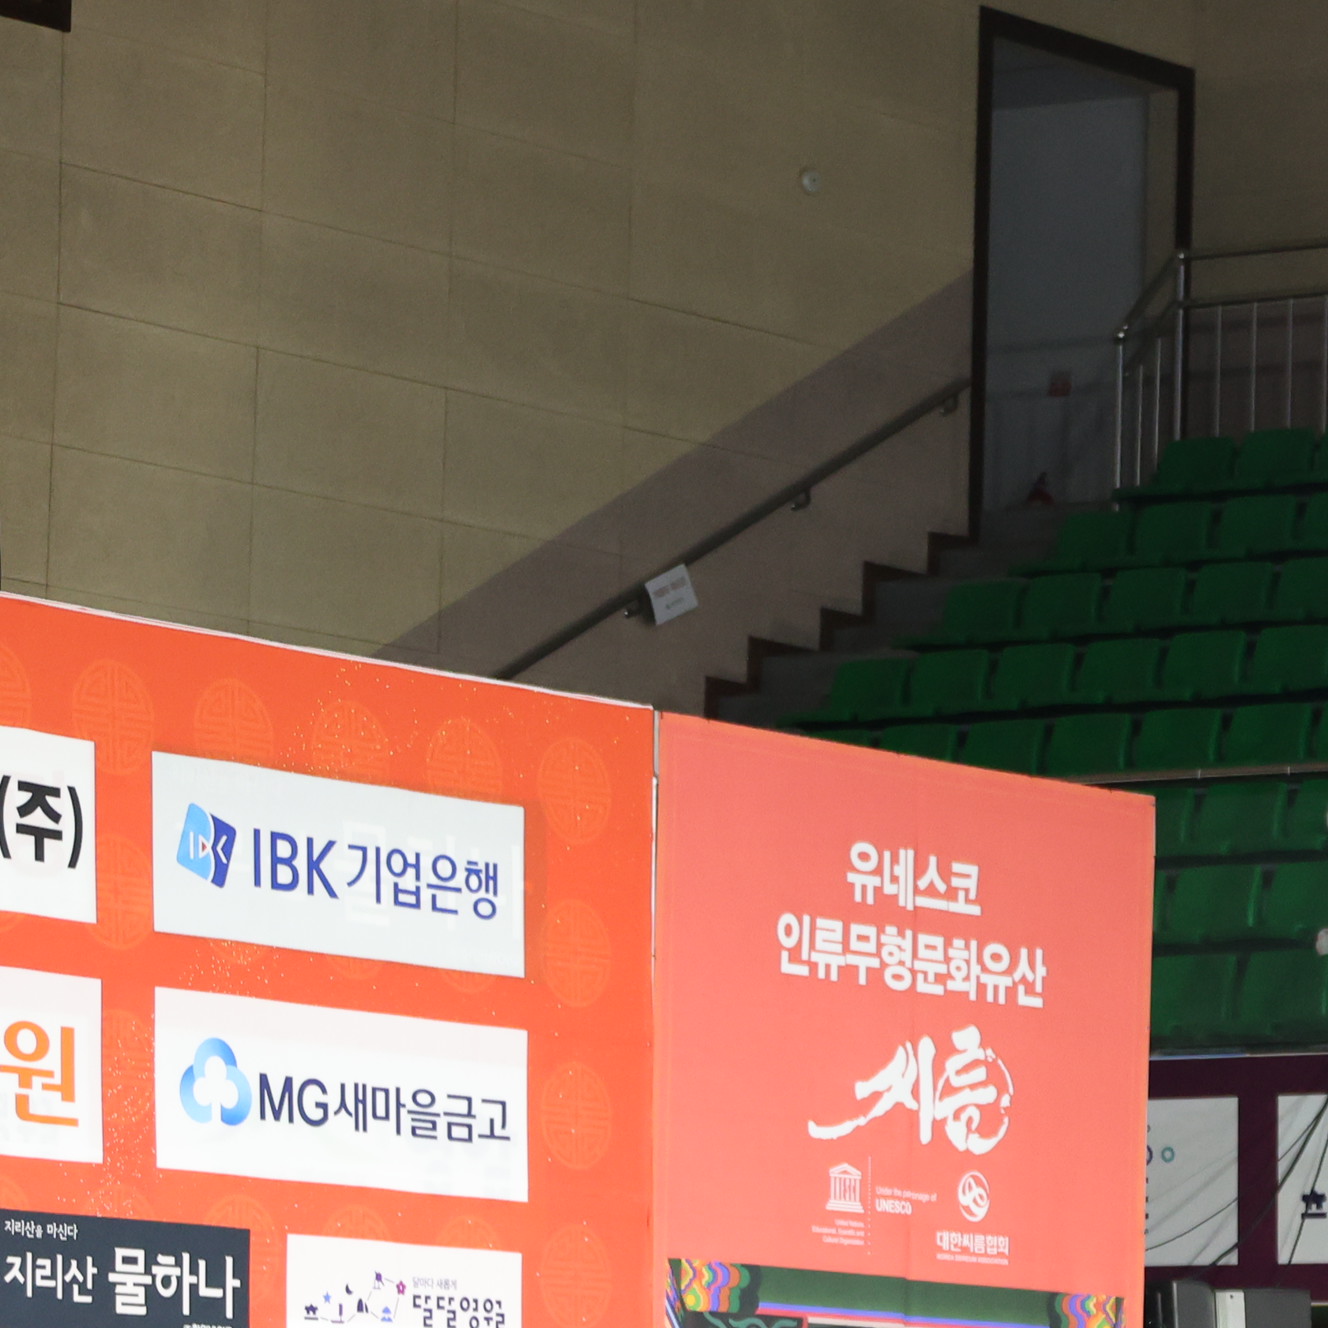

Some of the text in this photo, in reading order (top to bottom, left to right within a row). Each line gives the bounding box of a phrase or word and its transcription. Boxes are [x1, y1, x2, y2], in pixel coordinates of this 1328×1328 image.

[846, 841, 982, 916] 유네스코
[776, 911, 1047, 1008] 인류무형문화유산
[259, 1072, 511, 1143] MG새마을금고
[807, 1025, 1014, 1156] 씨름
[4, 1218, 78, 1241] 지리산을 마신다
[875, 1198, 912, 1215] UNESCO
[936, 1230, 1009, 1256] 대한씨름협회
[3, 1247, 241, 1320] 지리산 물하나
